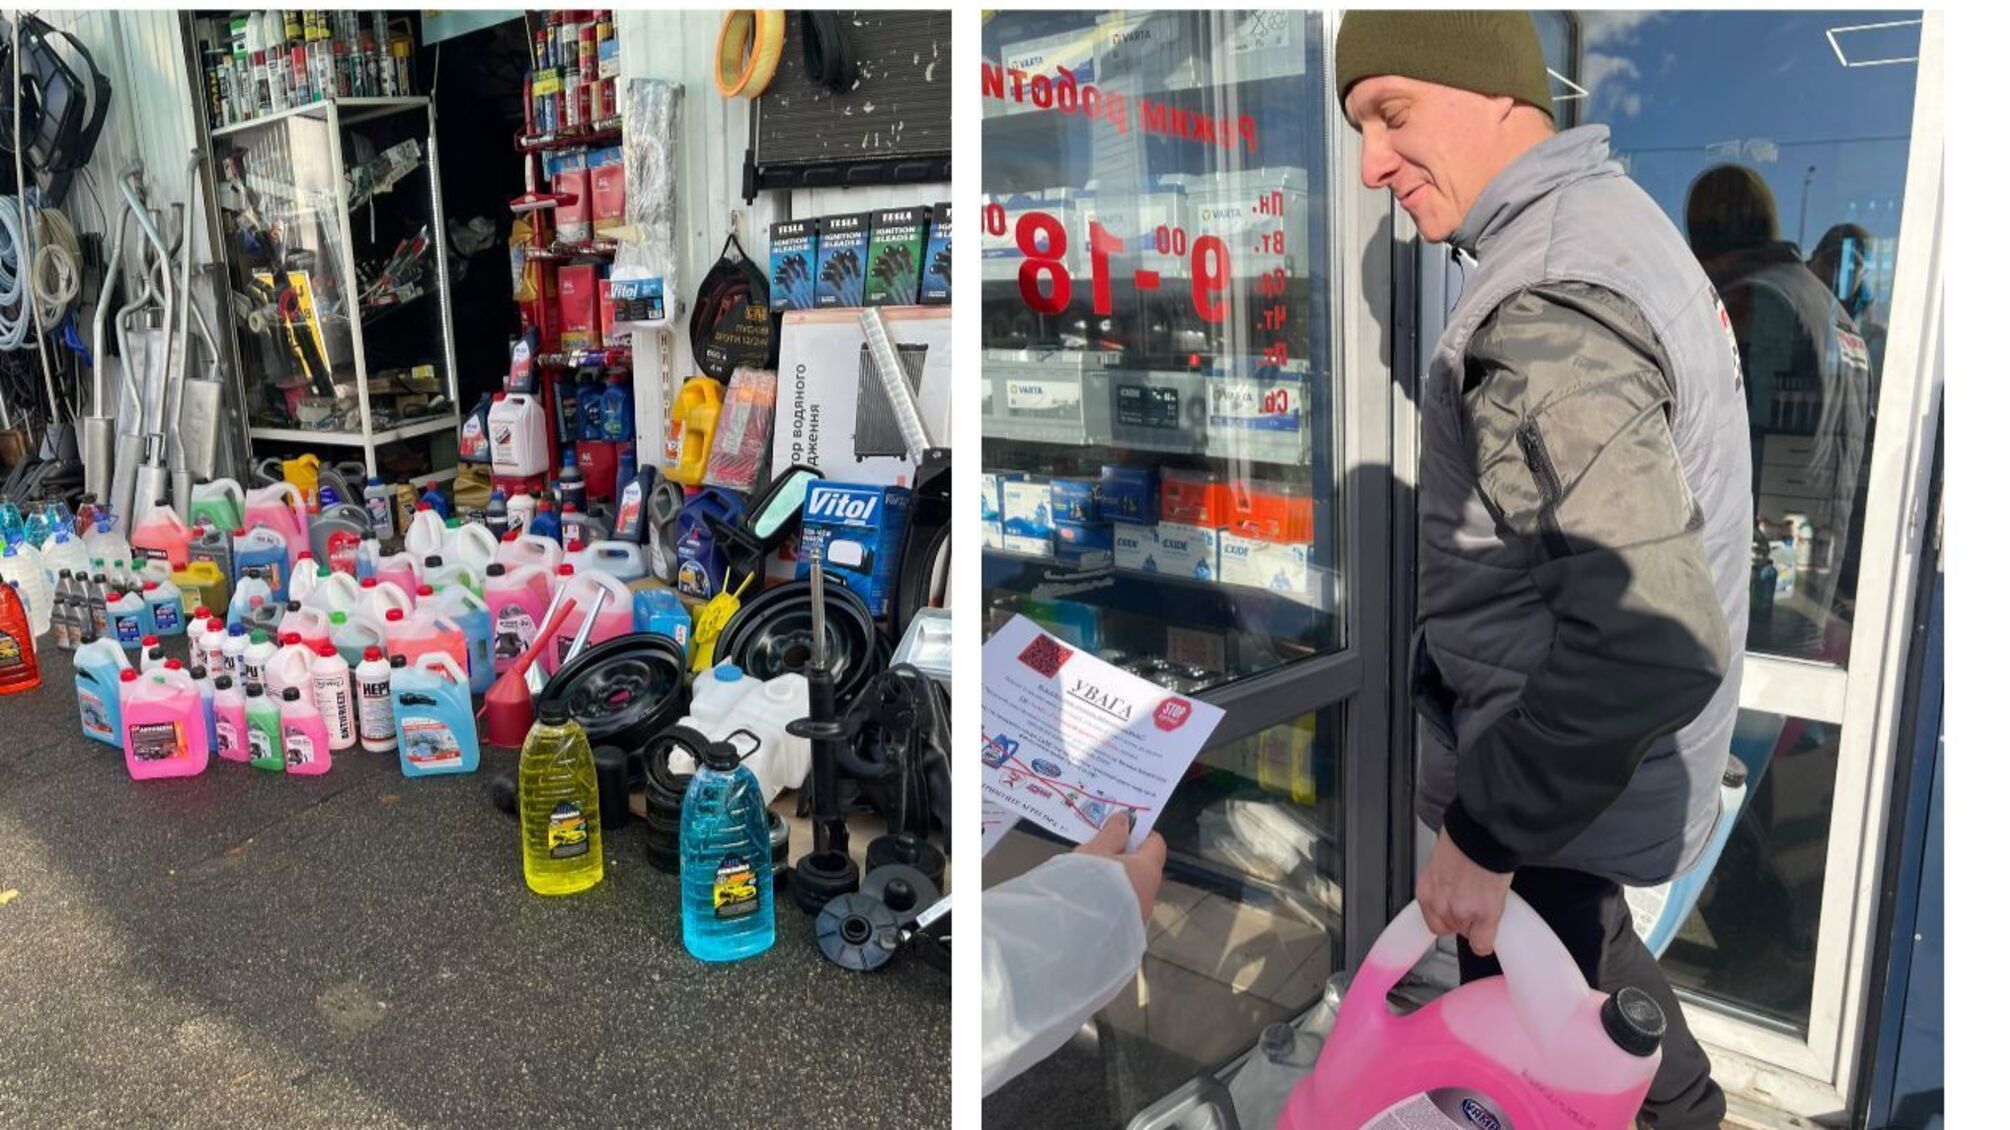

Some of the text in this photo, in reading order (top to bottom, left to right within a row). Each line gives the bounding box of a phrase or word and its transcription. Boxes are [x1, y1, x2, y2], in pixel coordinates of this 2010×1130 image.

[830, 217, 859, 228] TESLA
[882, 211, 912, 222] TESLA
[778, 223, 804, 234] TESLA
[793, 363, 807, 439] водяного
[808, 487, 879, 520] Vitol
[1071, 679, 1134, 719] УВАГА
